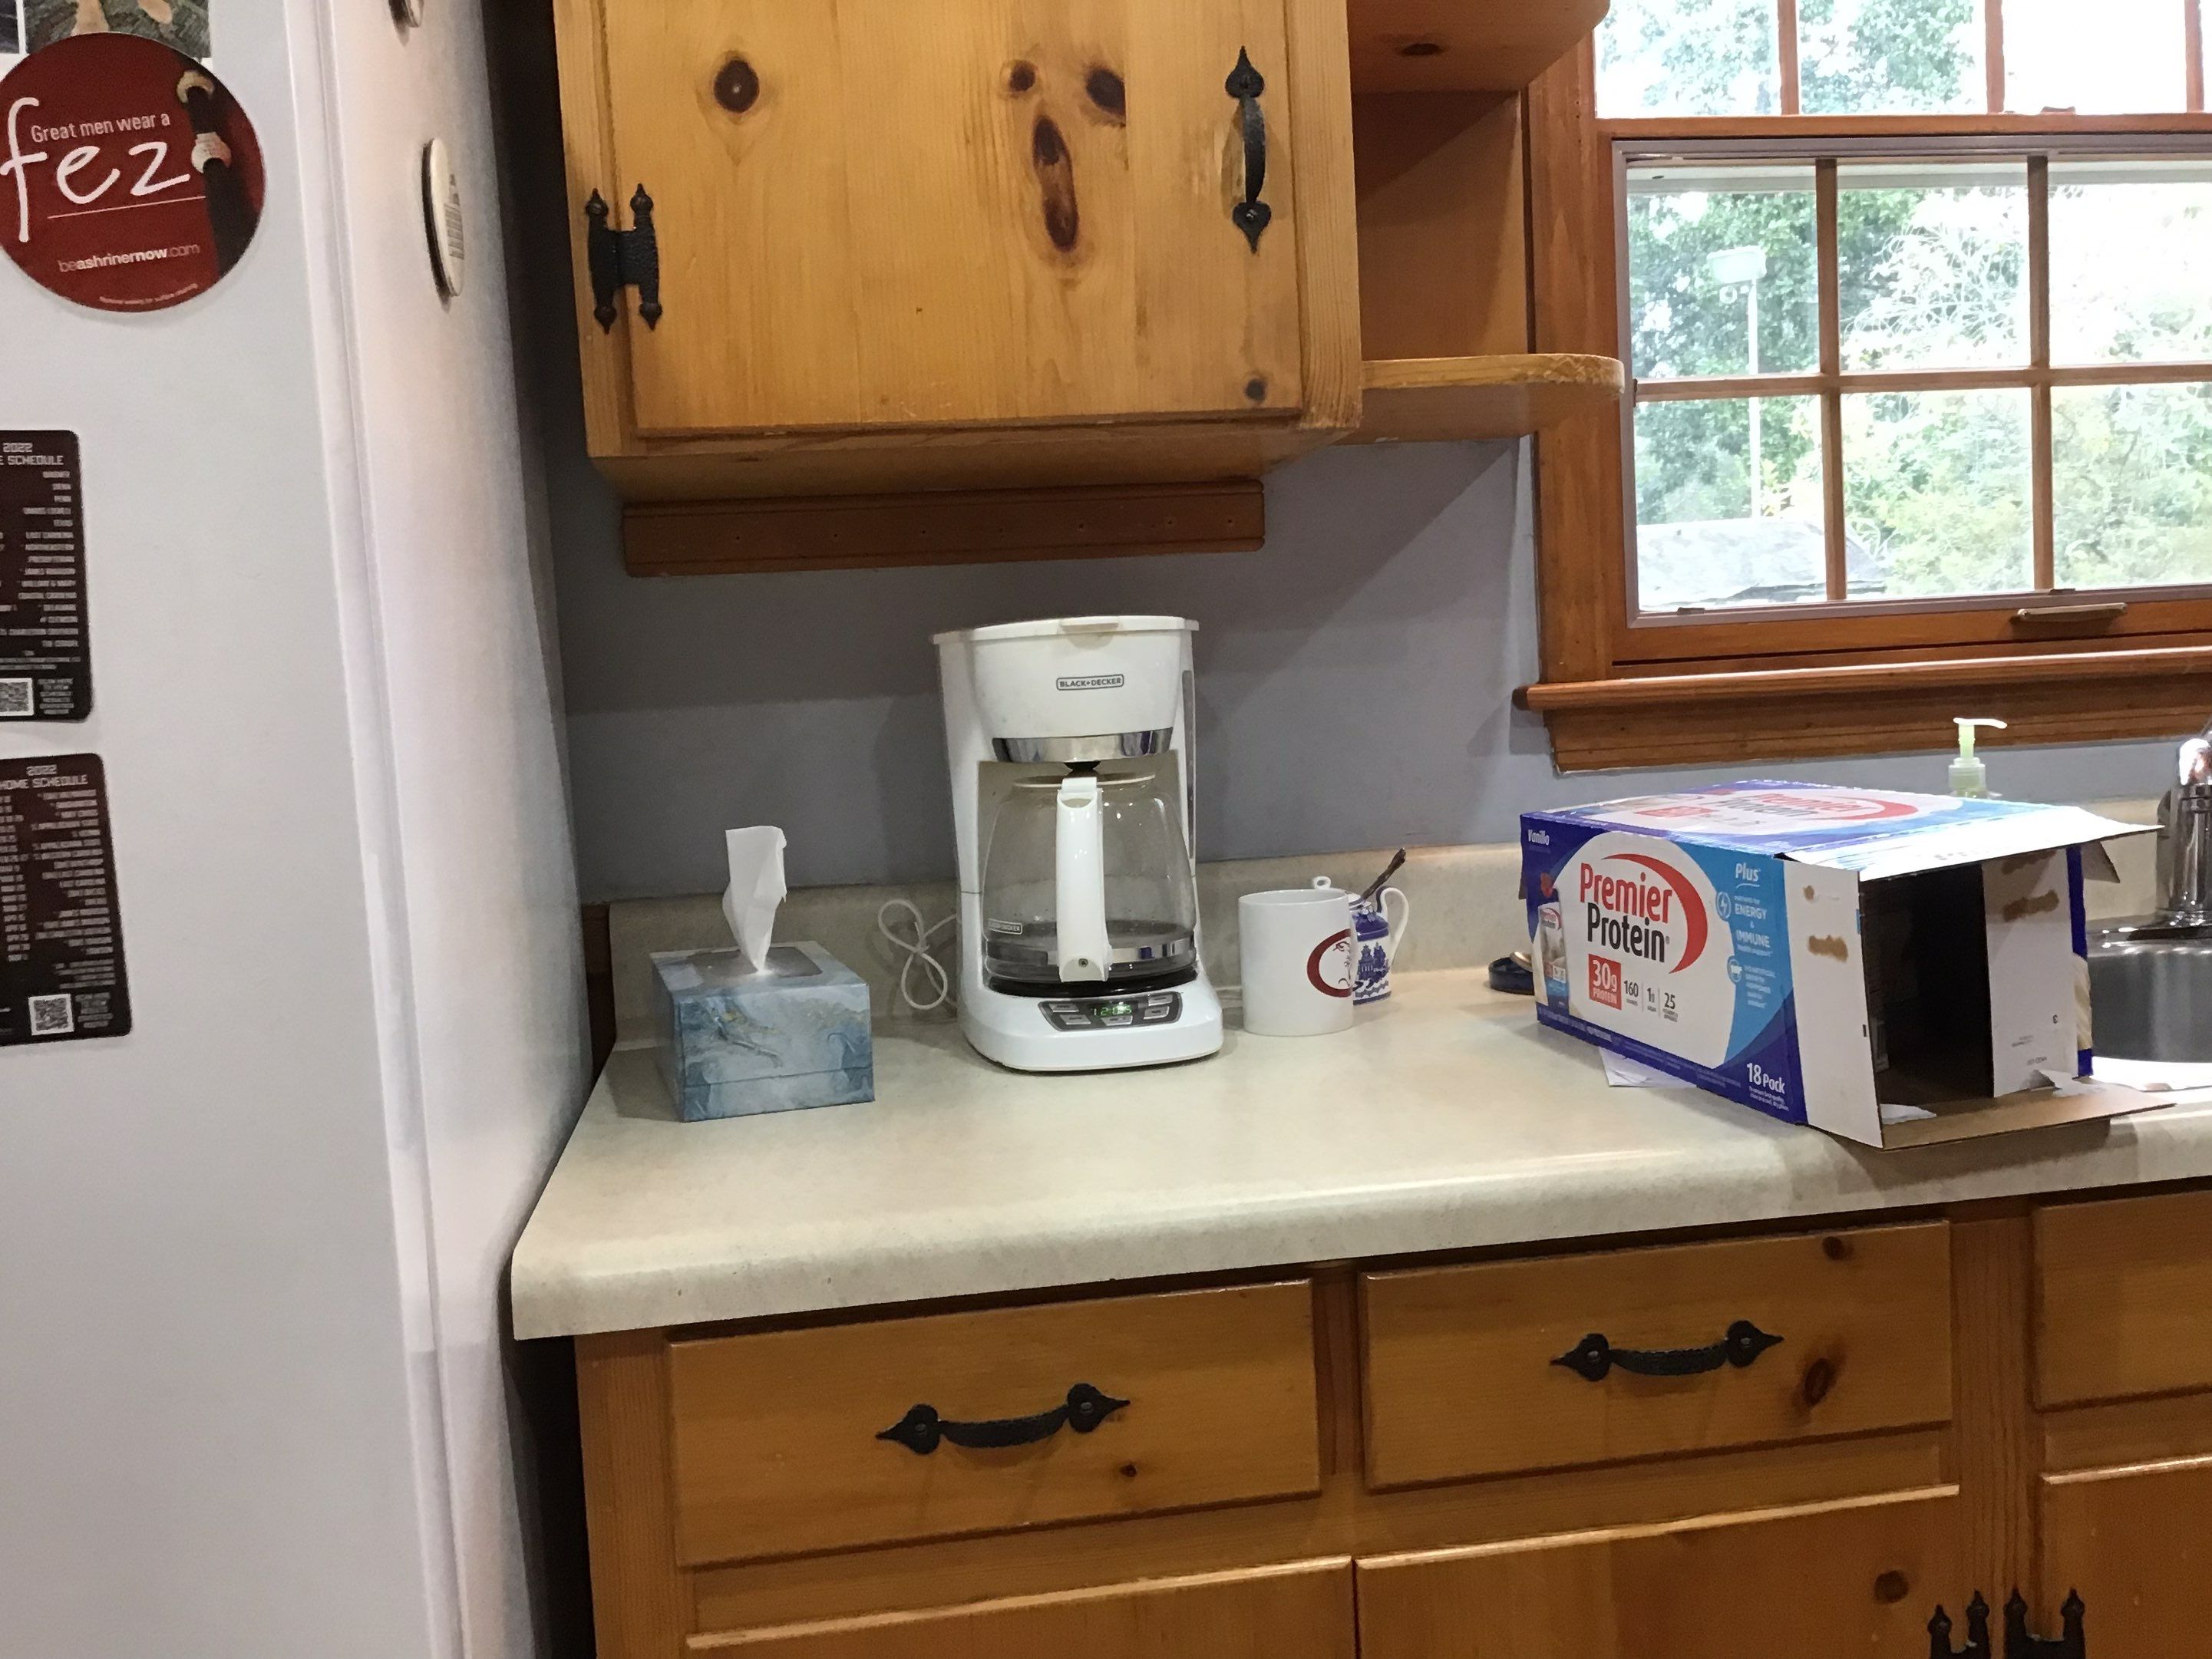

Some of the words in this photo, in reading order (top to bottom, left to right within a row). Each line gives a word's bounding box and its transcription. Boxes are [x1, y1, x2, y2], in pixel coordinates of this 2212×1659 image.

[31, 124, 77, 143] Great
[79, 120, 114, 137] men
[116, 114, 157, 133] wear
[160, 113, 170, 127] a
[0, 97, 191, 243] fez
[58, 244, 200, 272] beashrinernow.com
[8, 455, 64, 466] SCHEDULE
[1059, 677, 1121, 688] BLACK+DECKER
[32, 774, 89, 788] SCHEDULE
[1528, 829, 1550, 846] Vanilla
[1735, 862, 1759, 882] Plus
[1580, 862, 1672, 924] Premier
[1735, 903, 1767, 920] ENERGY
[1587, 902, 1665, 963] Protein
[1736, 929, 1771, 948] IMMUNE
[1593, 959, 1618, 993] 30g
[1624, 980, 1639, 998] 160
[1664, 992, 1676, 1010] 25
[1746, 1062, 1761, 1086] 18
[1762, 1073, 1786, 1095] Pack
